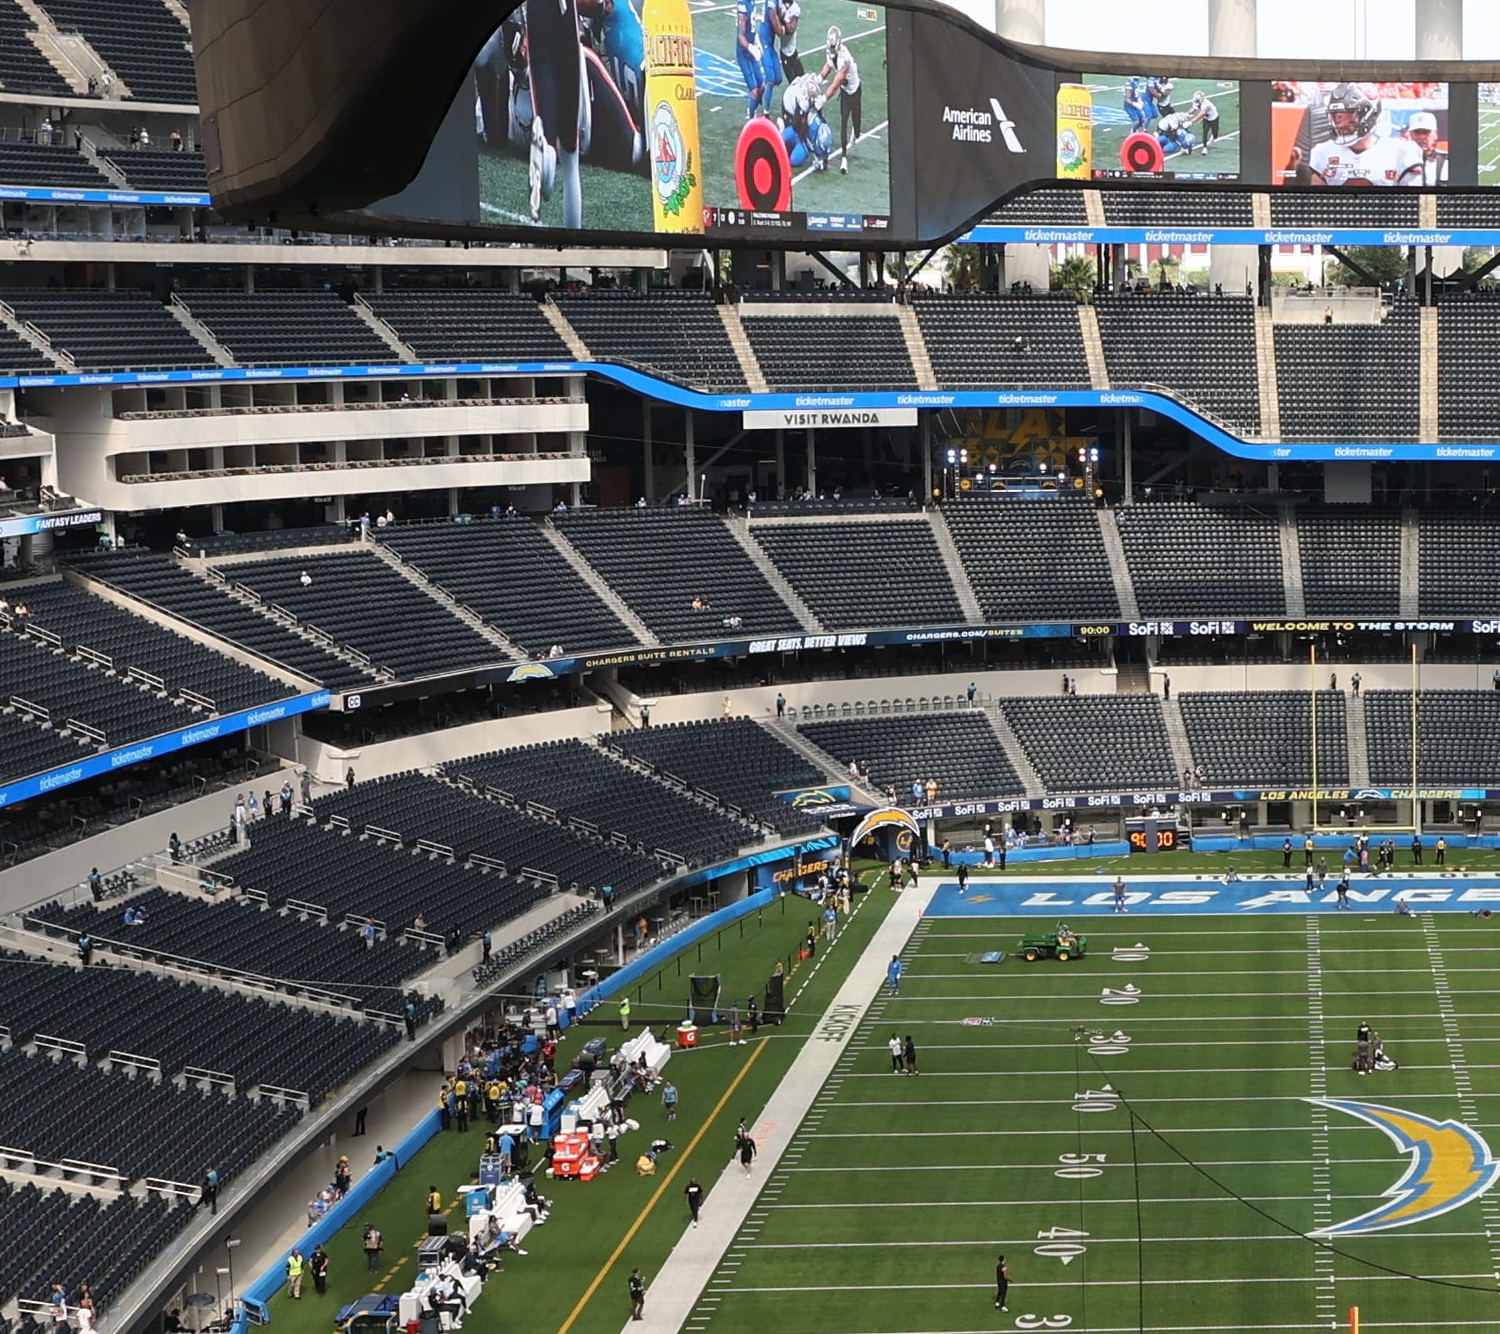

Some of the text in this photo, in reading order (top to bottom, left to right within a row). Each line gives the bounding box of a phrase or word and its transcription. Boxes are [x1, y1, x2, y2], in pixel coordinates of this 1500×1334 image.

[943, 105, 992, 126] American
[952, 124, 992, 143] Airlines
[1143, 230, 1216, 243] ticketmaster
[997, 393, 1059, 404] ticketmaster
[784, 412, 880, 425] VISIT RWANDA
[35, 512, 102, 531] FANTASY LEADERS
[906, 628, 1024, 641] CHARGERS.COM/SUITES
[1080, 625, 1110, 635] 90:00
[1128, 621, 1158, 636] SoFi
[1189, 620, 1220, 635] SoFi
[1252, 622, 1454, 632] WELCOME TO THE STORM
[749, 640, 777, 655] GREAT
[805, 635, 837, 650] BETTER
[838, 633, 867, 648] VIEWS
[586, 646, 716, 668] CHARGERS SUITE RENTALS
[1088, 796, 1109, 806] SoFi
[1178, 793, 1200, 804] SoFi
[1260, 790, 1462, 800] LOS ANGELES CHARGERS
[1131, 831, 1173, 847] 9000
[772, 859, 830, 883] CHAGERS
[1020, 889, 1220, 907] LOS
[1111, 946, 1151, 962] 10
[813, 1003, 861, 1043] KICKOFF
[1054, 1152, 1108, 1179] 50
